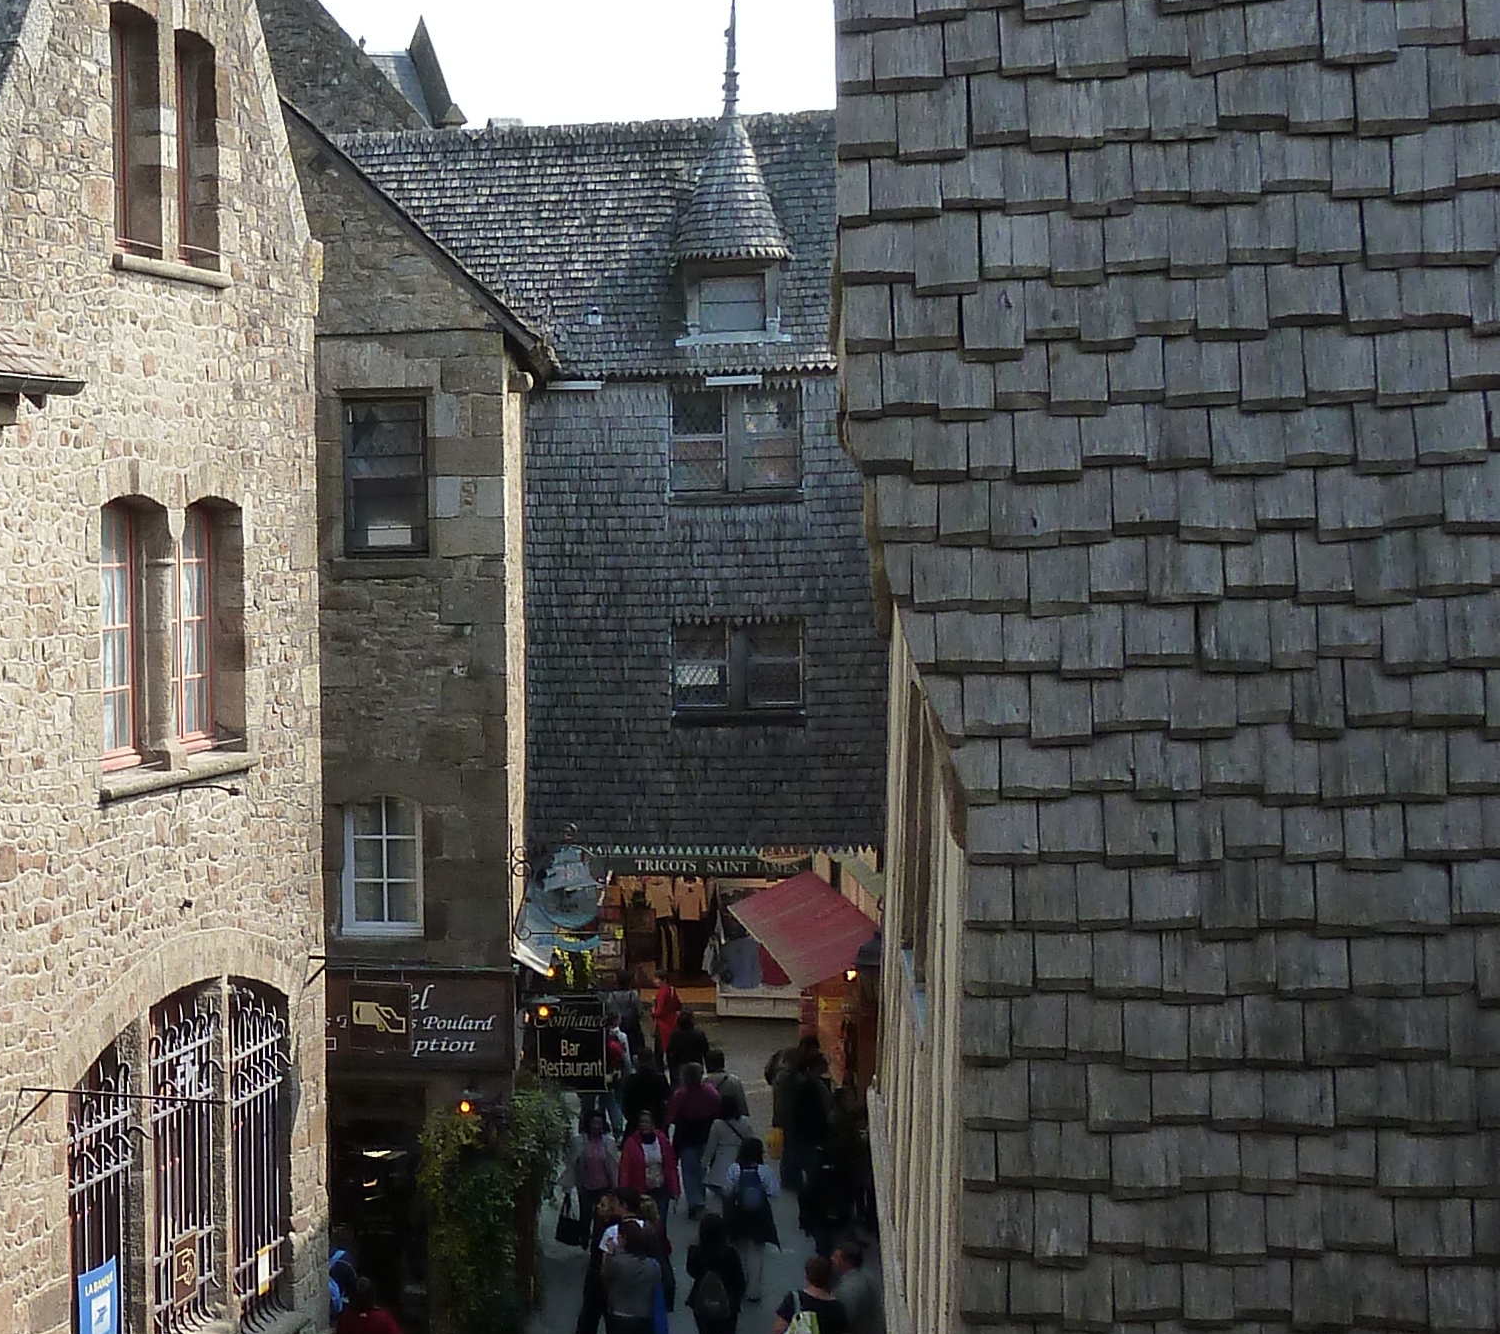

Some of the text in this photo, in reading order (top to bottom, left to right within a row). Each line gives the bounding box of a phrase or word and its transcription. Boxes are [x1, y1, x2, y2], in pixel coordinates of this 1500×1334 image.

[635, 859, 800, 874] TRICOTS SAINT JAMES
[422, 1014, 497, 1033] Poulard
[411, 1036, 477, 1058] ption
[561, 1039, 580, 1056] Bar
[539, 1058, 603, 1077] Restaurant
